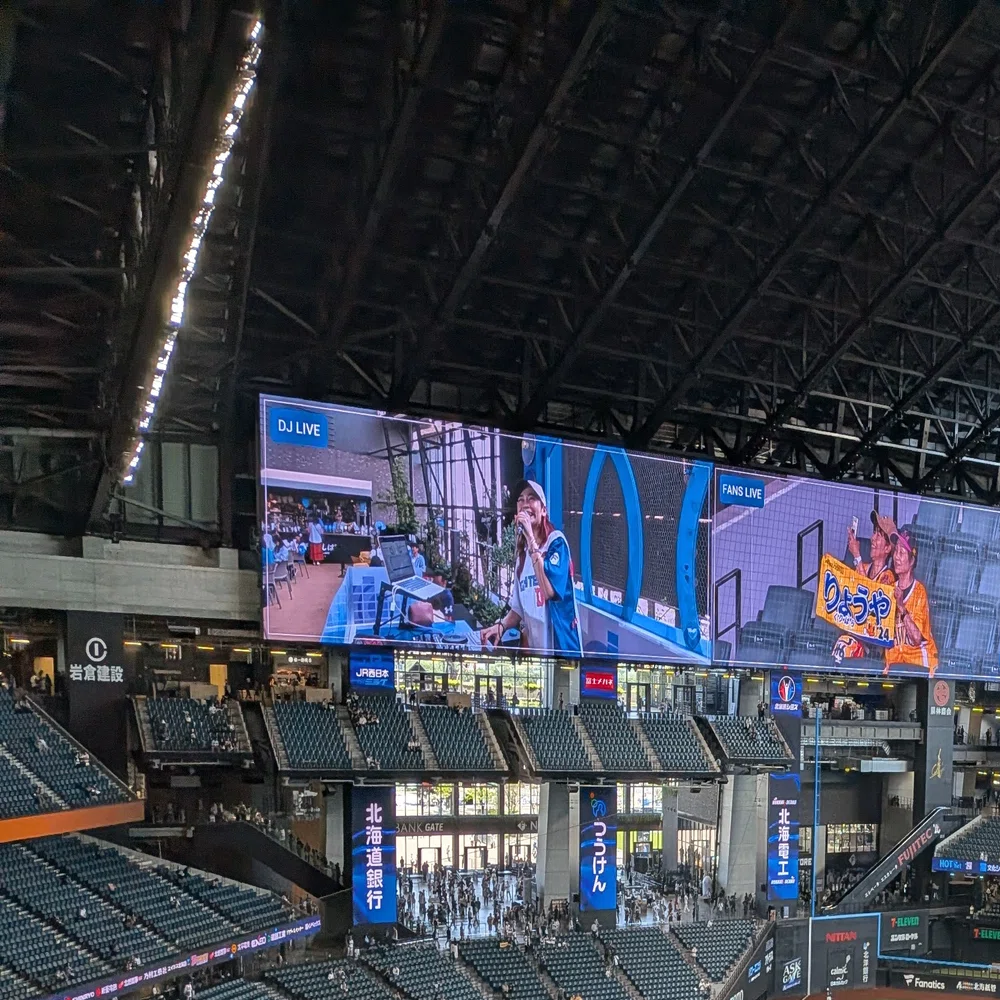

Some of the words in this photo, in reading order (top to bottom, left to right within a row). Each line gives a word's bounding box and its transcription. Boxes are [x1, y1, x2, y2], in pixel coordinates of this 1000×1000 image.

[277, 419, 293, 433] DJ
[296, 420, 321, 437] LIVE
[722, 484, 743, 498] FANS
[745, 486, 762, 500] LIVE
[824, 570, 892, 626] りょうや
[69, 664, 123, 684] 岩倉建設
[355, 668, 389, 678] JR西日本
[425, 823, 444, 832] GATE
[778, 808, 790, 876] 北海電工
[897, 828, 933, 866] FUJITEC
[365, 803, 383, 911] 北海道銀行
[591, 821, 607, 893] つうけん
[825, 931, 857, 943] NITTAN
[915, 978, 945, 990] Fanatics
